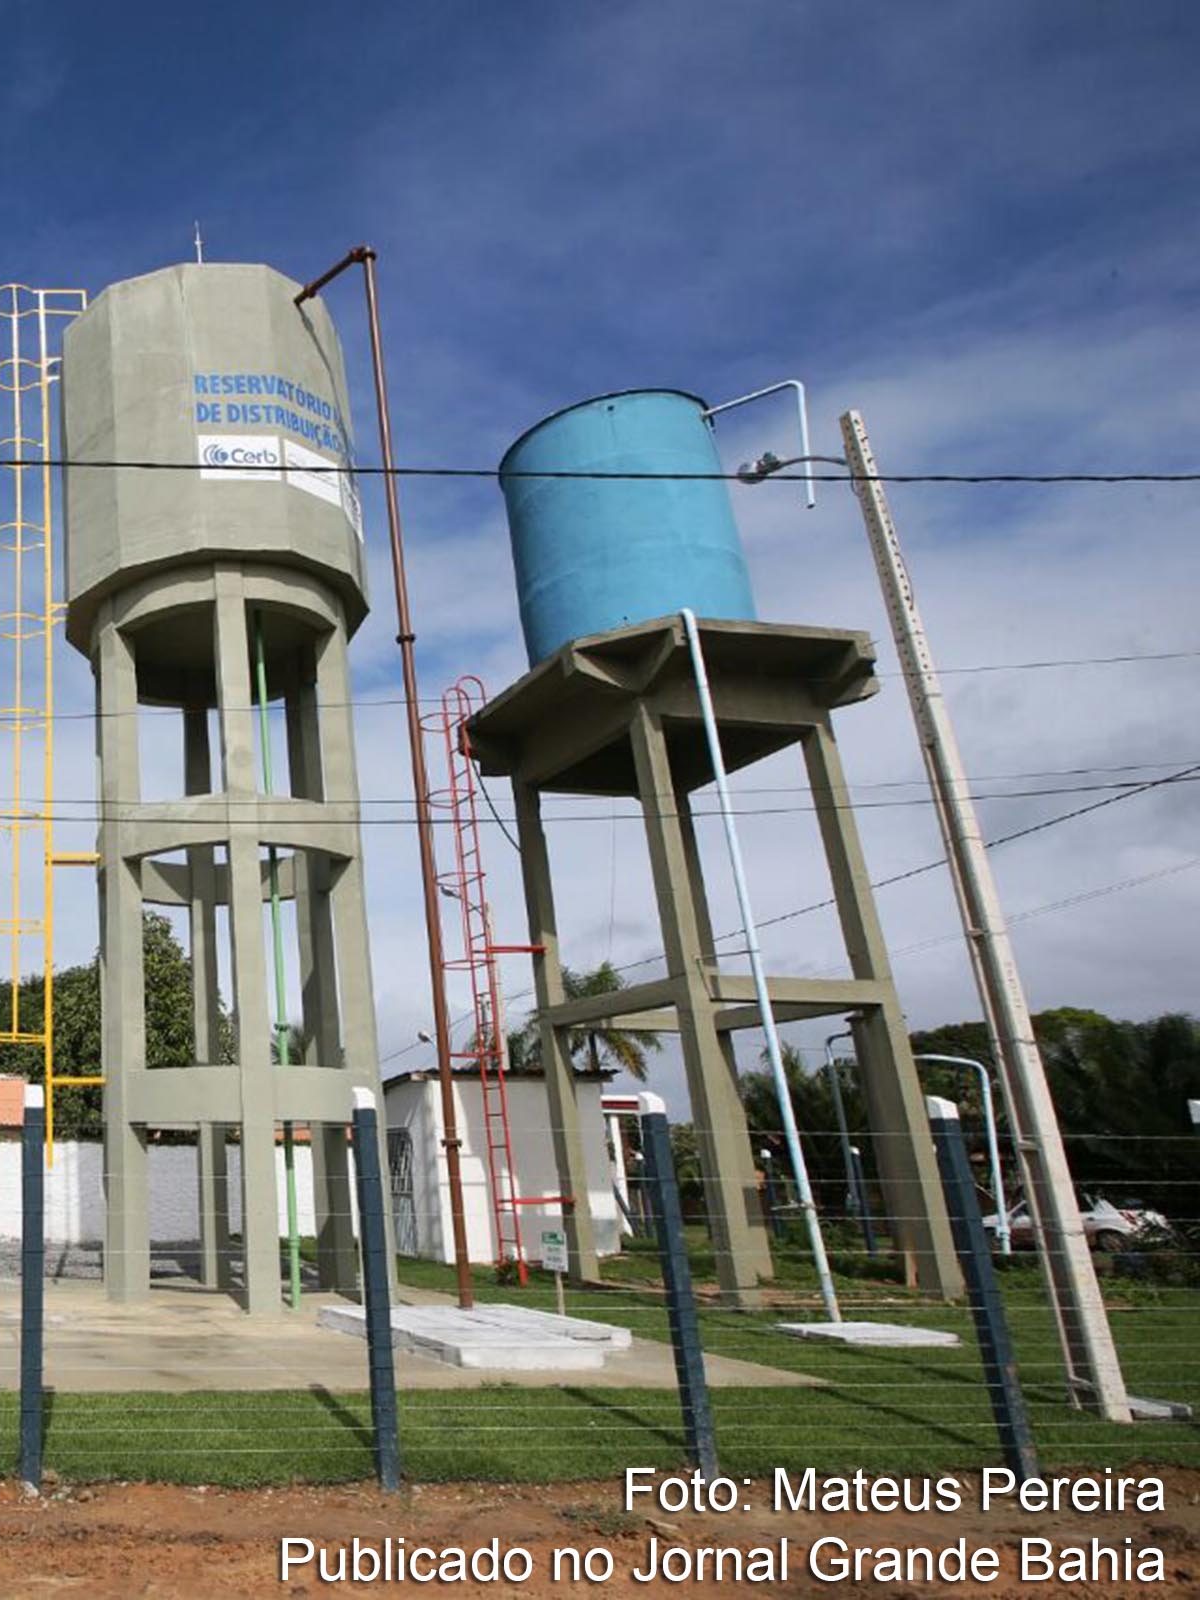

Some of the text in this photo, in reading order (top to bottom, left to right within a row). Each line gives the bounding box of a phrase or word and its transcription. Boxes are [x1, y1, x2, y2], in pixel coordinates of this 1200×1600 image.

[194, 374, 331, 420] RESERVATÓRIO
[196, 403, 221, 422] DE
[231, 448, 277, 464] Cerb
